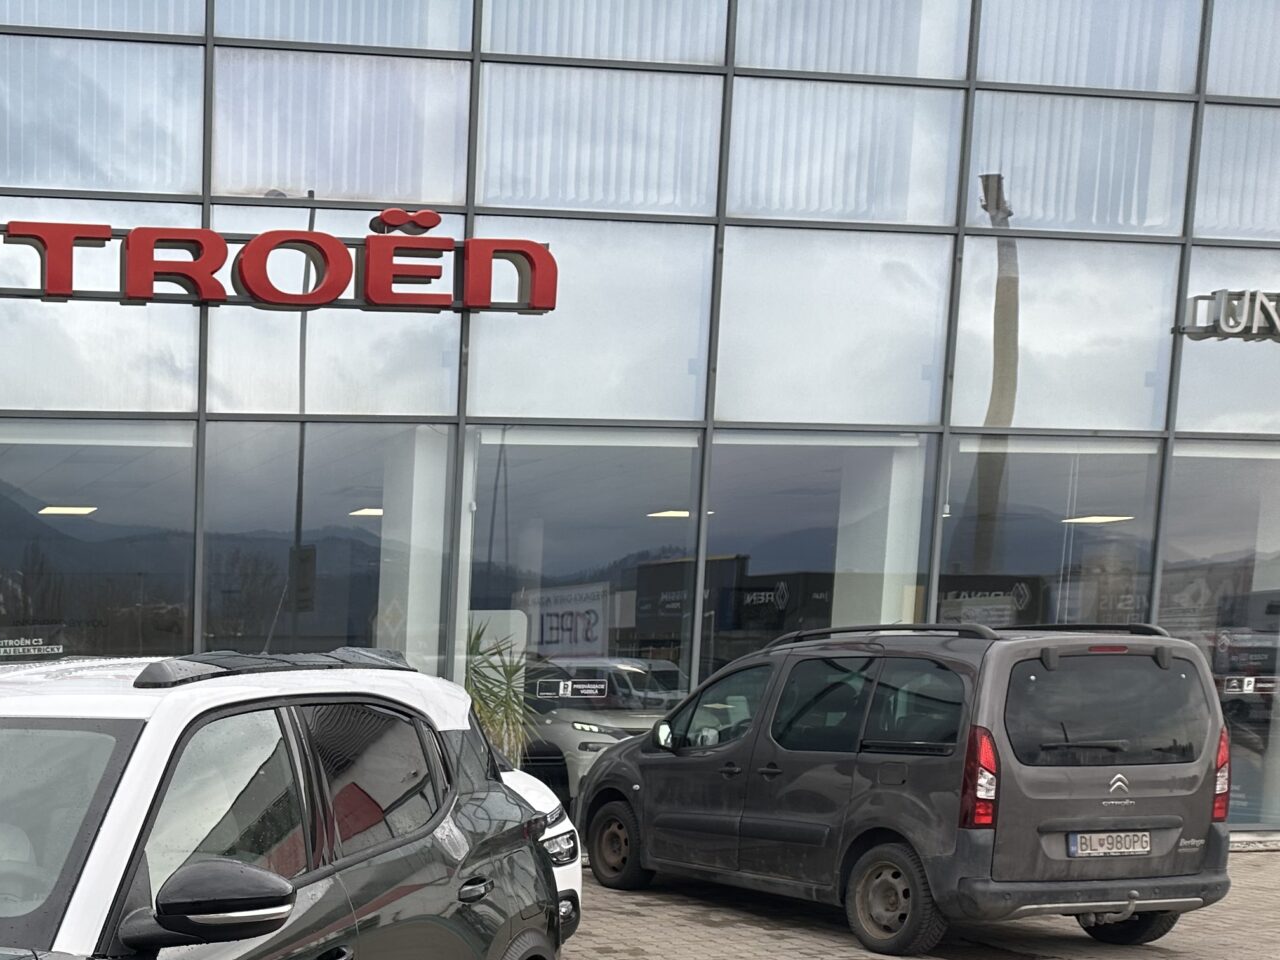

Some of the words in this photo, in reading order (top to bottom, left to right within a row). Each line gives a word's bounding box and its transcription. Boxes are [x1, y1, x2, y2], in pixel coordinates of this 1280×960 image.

[32, 638, 43, 646] C3
[1079, 836, 1098, 851] BL
[1106, 834, 1149, 850] 980PG
